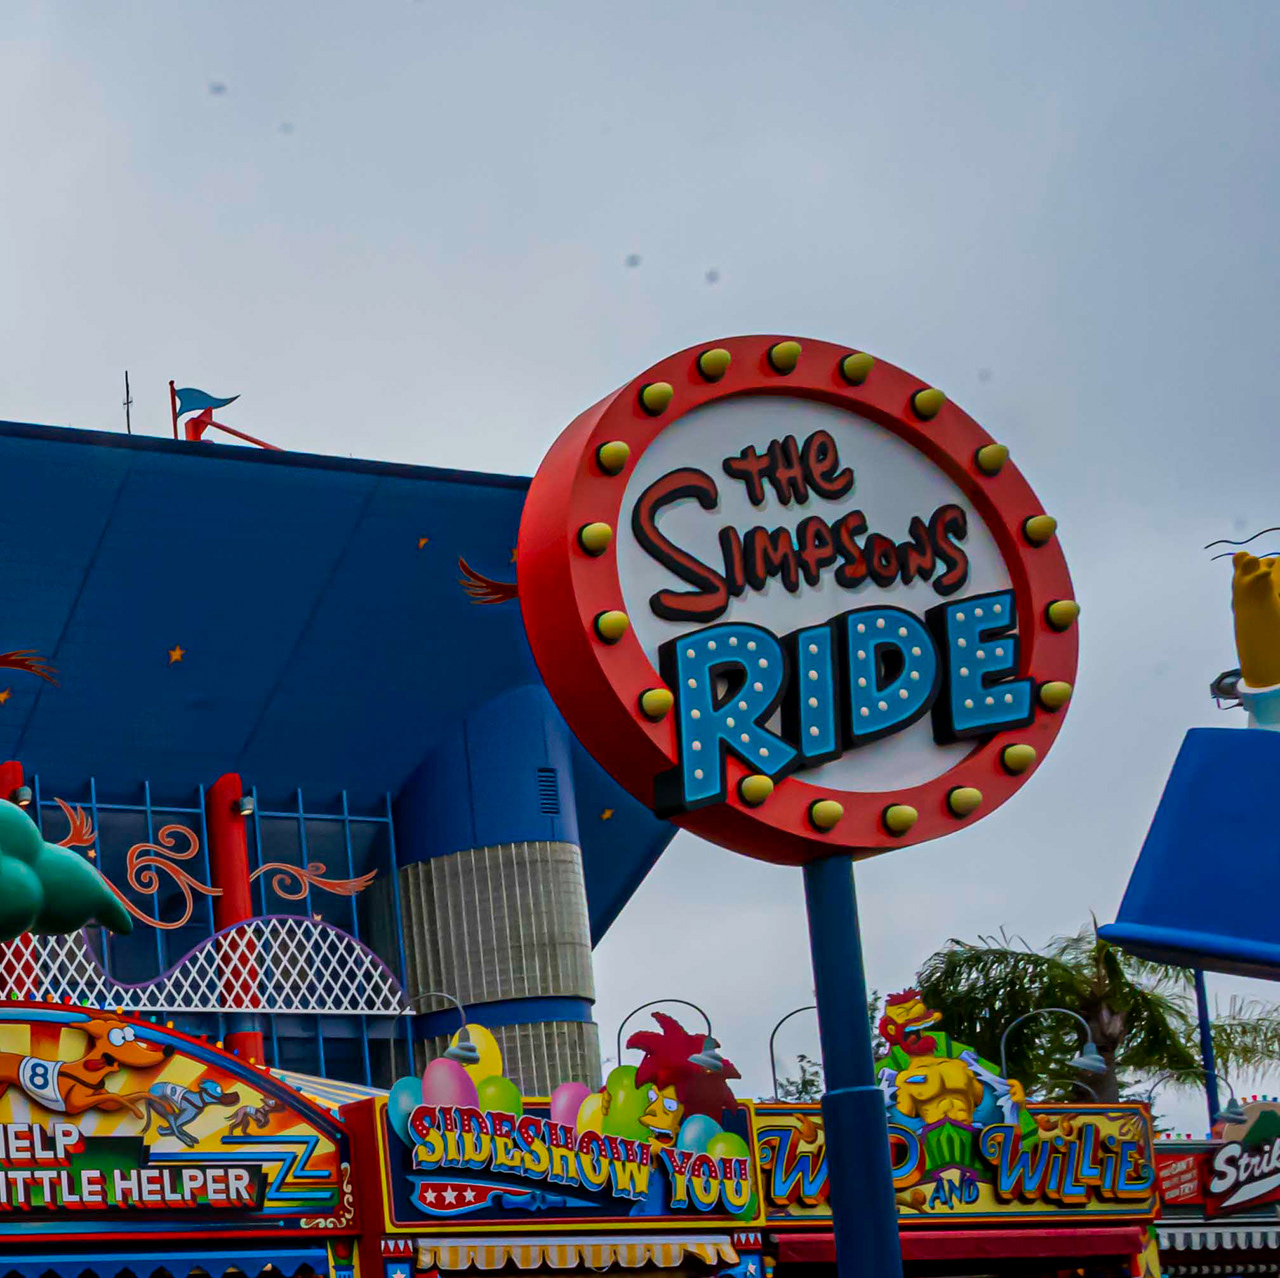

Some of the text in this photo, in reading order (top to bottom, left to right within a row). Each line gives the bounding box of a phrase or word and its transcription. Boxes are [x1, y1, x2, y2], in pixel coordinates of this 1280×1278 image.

[723, 430, 854, 506] THE
[632, 467, 968, 621] SIMPSONS
[656, 590, 1035, 818] RIDE
[29, 1062, 50, 1091] 8
[112, 1168, 253, 1208] HELPER
[407, 1104, 752, 1214] SIDESHOW YOU
[928, 1171, 980, 1210] AND
